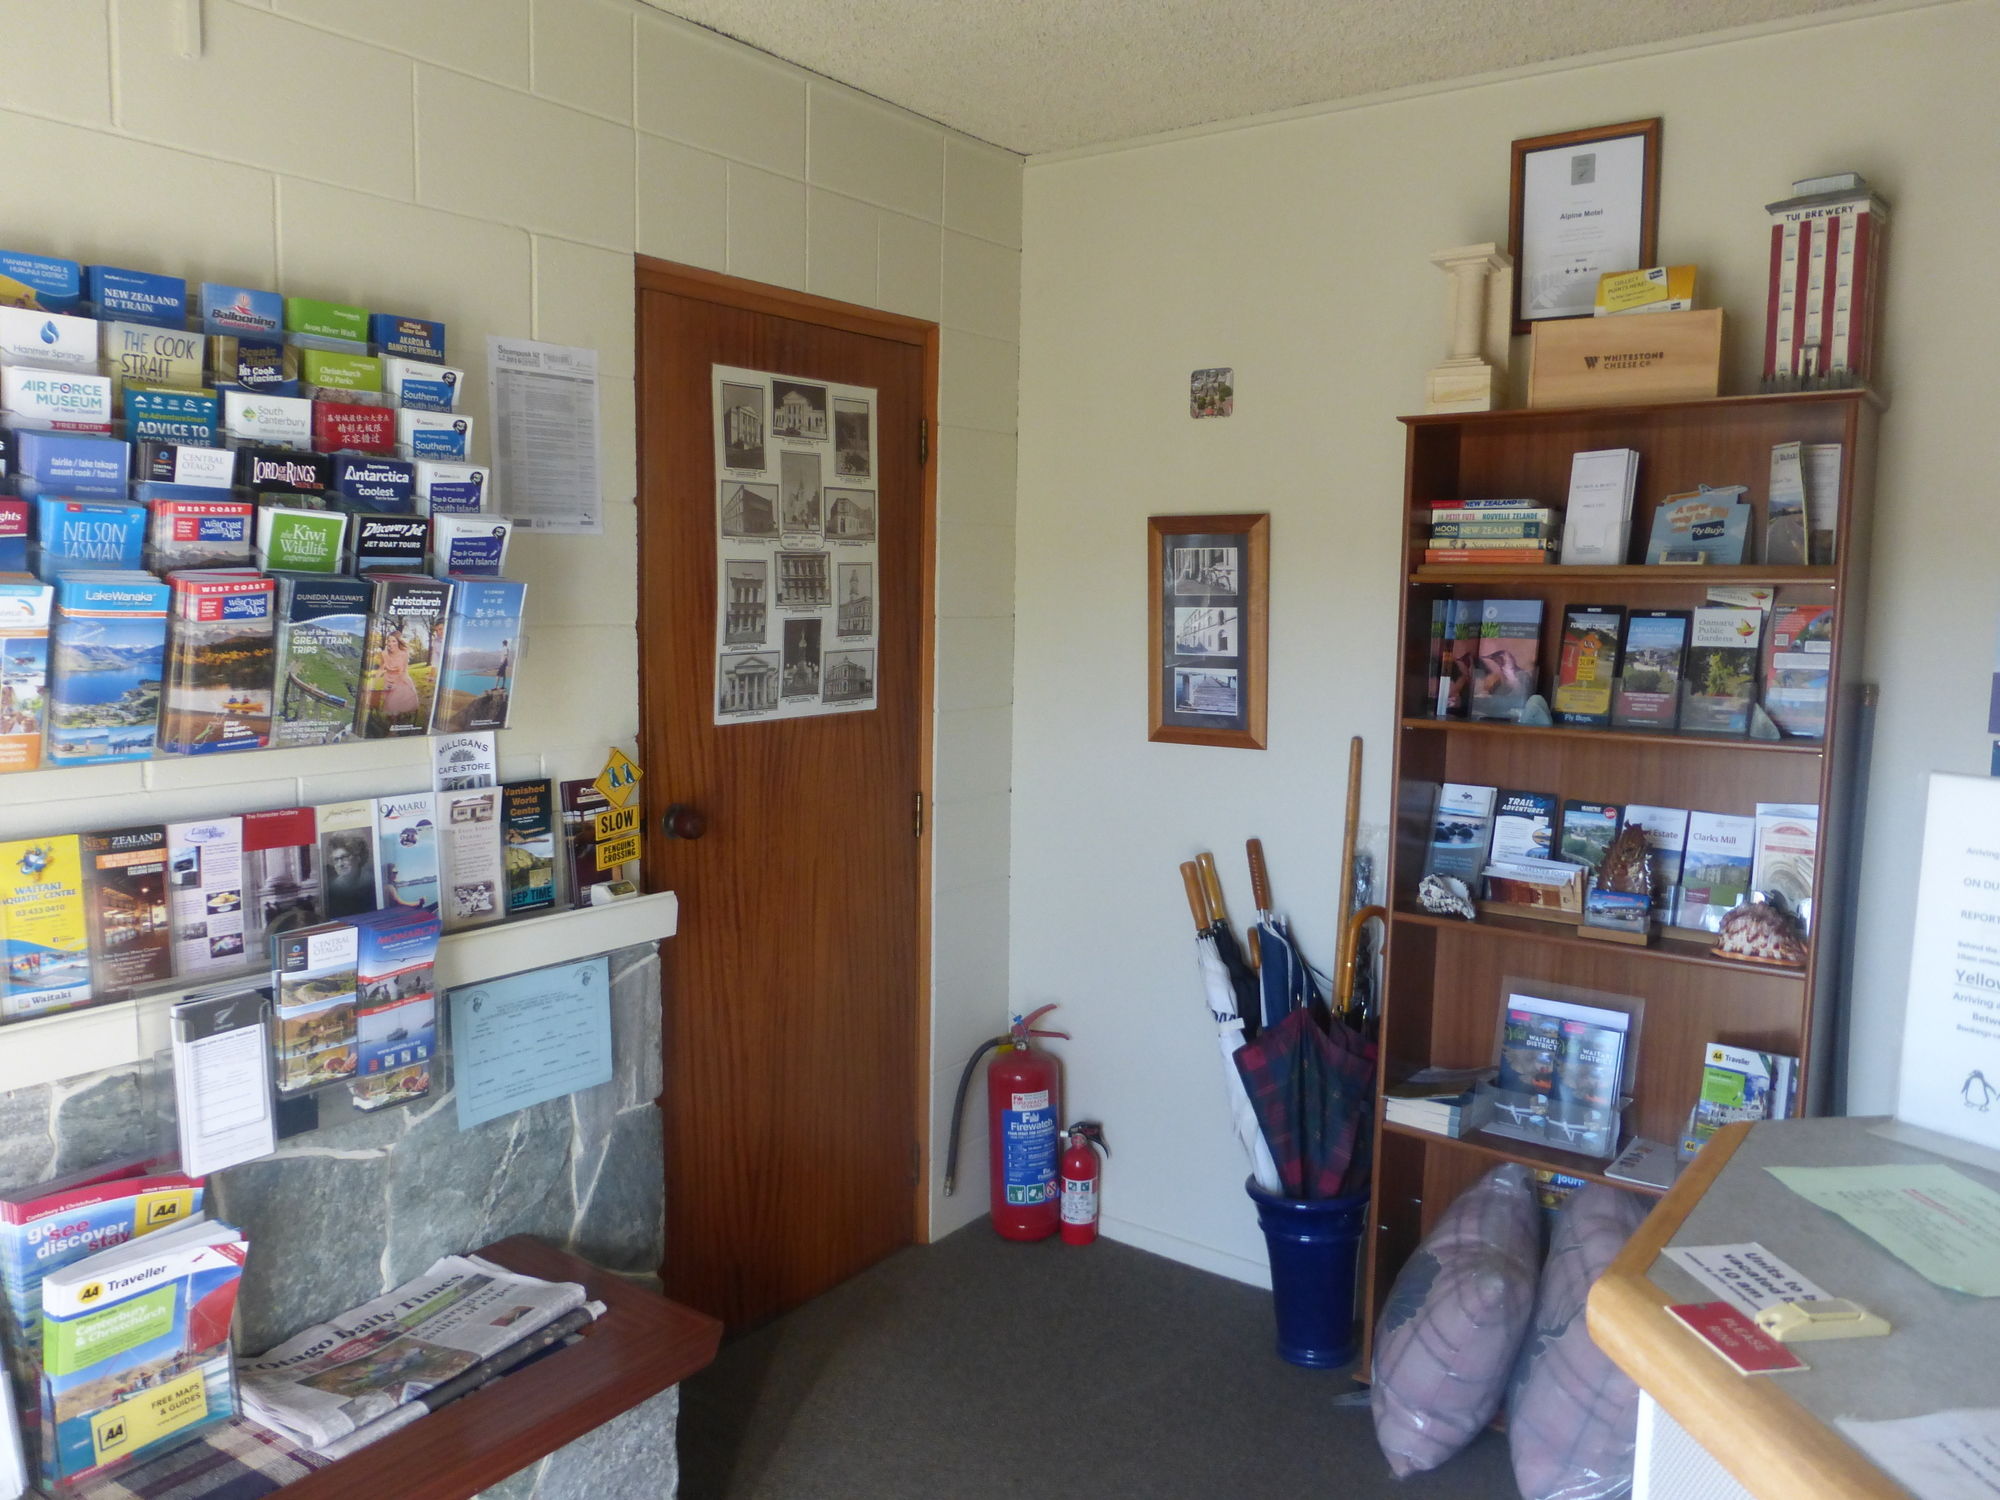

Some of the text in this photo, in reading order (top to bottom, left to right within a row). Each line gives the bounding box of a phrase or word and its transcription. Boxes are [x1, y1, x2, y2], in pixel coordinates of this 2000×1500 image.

[1560, 208, 1603, 220] Alpine Motel
[1785, 205, 1855, 221] TUI BREWERY
[104, 287, 179, 307] NEW ZEALAND
[104, 298, 153, 312] BY TRAIN
[212, 309, 276, 328] Ballooning
[304, 323, 321, 332] Avon
[322, 326, 339, 335] River
[124, 330, 197, 360] THE COOK
[400, 335, 424, 347] AKAROA
[13, 344, 85, 362] Hanmer Springs
[388, 342, 443, 358] BANKS PENINSULA
[1604, 351, 1664, 362] WHITESTONE
[121, 354, 173, 379] STRAIT
[252, 366, 275, 375] Cook
[1604, 360, 1637, 369] CHEESE
[21, 380, 102, 397] AIR FORCE
[403, 390, 439, 401] Southern
[36, 393, 102, 409] MUSEUM
[258, 405, 284, 416] South
[258, 416, 306, 428] Canterbury
[137, 421, 210, 438] ADVICE TO
[416, 441, 452, 451] Southern
[252, 456, 316, 487] LORD RINGS
[344, 465, 410, 483] Antarctica
[358, 486, 395, 497] coolest
[432, 503, 479, 513] South Island
[1483, 499, 1517, 507] ZEALAND
[1482, 512, 1538, 520] NOUVELLE ZELANDE
[63, 520, 127, 543] NELSON
[292, 523, 327, 542] Kiwi
[362, 522, 427, 537] Discovery Jet
[1461, 527, 1479, 535] NEW
[1480, 526, 1522, 535] ZEALAND
[63, 541, 125, 560] TASMAN
[280, 539, 329, 556] Wildlife
[451, 557, 498, 567] South Island
[85, 589, 153, 601] LakeWanaka
[201, 583, 266, 593] WEST COAST
[330, 594, 364, 602] RAILWAYS
[392, 596, 441, 607] christchurch
[389, 605, 440, 617] & canterbury
[1698, 619, 1735, 627] Oamaru
[1699, 627, 1725, 635] Public
[292, 636, 352, 645] GREAT TRAIN
[293, 645, 318, 654] TRIPS
[438, 738, 489, 755] MILLIGANS
[438, 762, 491, 775] CAFE STORE
[504, 784, 545, 796] Vanished
[512, 796, 538, 806] World
[1508, 797, 1534, 807] TRAIL
[510, 806, 541, 817] Centre
[1501, 804, 1545, 814] ADVENTURES
[601, 808, 634, 834] SLOW
[111, 832, 162, 846] ZEALAND
[1653, 830, 1679, 839] Estate
[1693, 832, 1737, 844] Clarks Mill
[603, 838, 635, 855] PENGUINS
[603, 848, 636, 864] CROSSING
[14, 882, 63, 895] WAITAKI
[1963, 877, 1980, 888] ON
[44, 889, 76, 899] CENTRE
[531, 886, 552, 900] TIME
[31, 991, 72, 1006] Waitaki
[1952, 992, 1994, 1011] Arriving
[1526, 1040, 1558, 1051] DISTRICT
[1529, 1034, 1559, 1045] WAITAKI
[1579, 1054, 1611, 1065] DISTRICT
[1582, 1048, 1612, 1059] WAITAKI
[1713, 1052, 1750, 1066] AA Traveller
[1010, 1118, 1053, 1131] Firewatch
[26, 1208, 60, 1222] Canterbury
[65, 1197, 103, 1210] Christchurch
[153, 1203, 177, 1218] AA
[27, 1221, 57, 1246] go
[48, 1220, 89, 1240] see
[36, 1221, 129, 1260] discover
[88, 1230, 132, 1253] stay
[1724, 1253, 1787, 1295] vacated
[1744, 1252, 1804, 1293] Units to
[81, 1264, 167, 1300] AA Traveller
[1718, 1266, 1765, 1299] 10 am
[76, 1304, 148, 1336] Canterbury
[89, 1305, 167, 1343] Christchurch
[257, 1272, 466, 1371] Otago Daily Times
[1707, 1324, 1742, 1348] RING
[1722, 1317, 1772, 1353] PLEASE
[151, 1382, 200, 1410] FREE MAPS
[159, 1408, 167, 1416] &
[168, 1392, 201, 1412] GUIDES
[105, 1423, 124, 1442] AA
